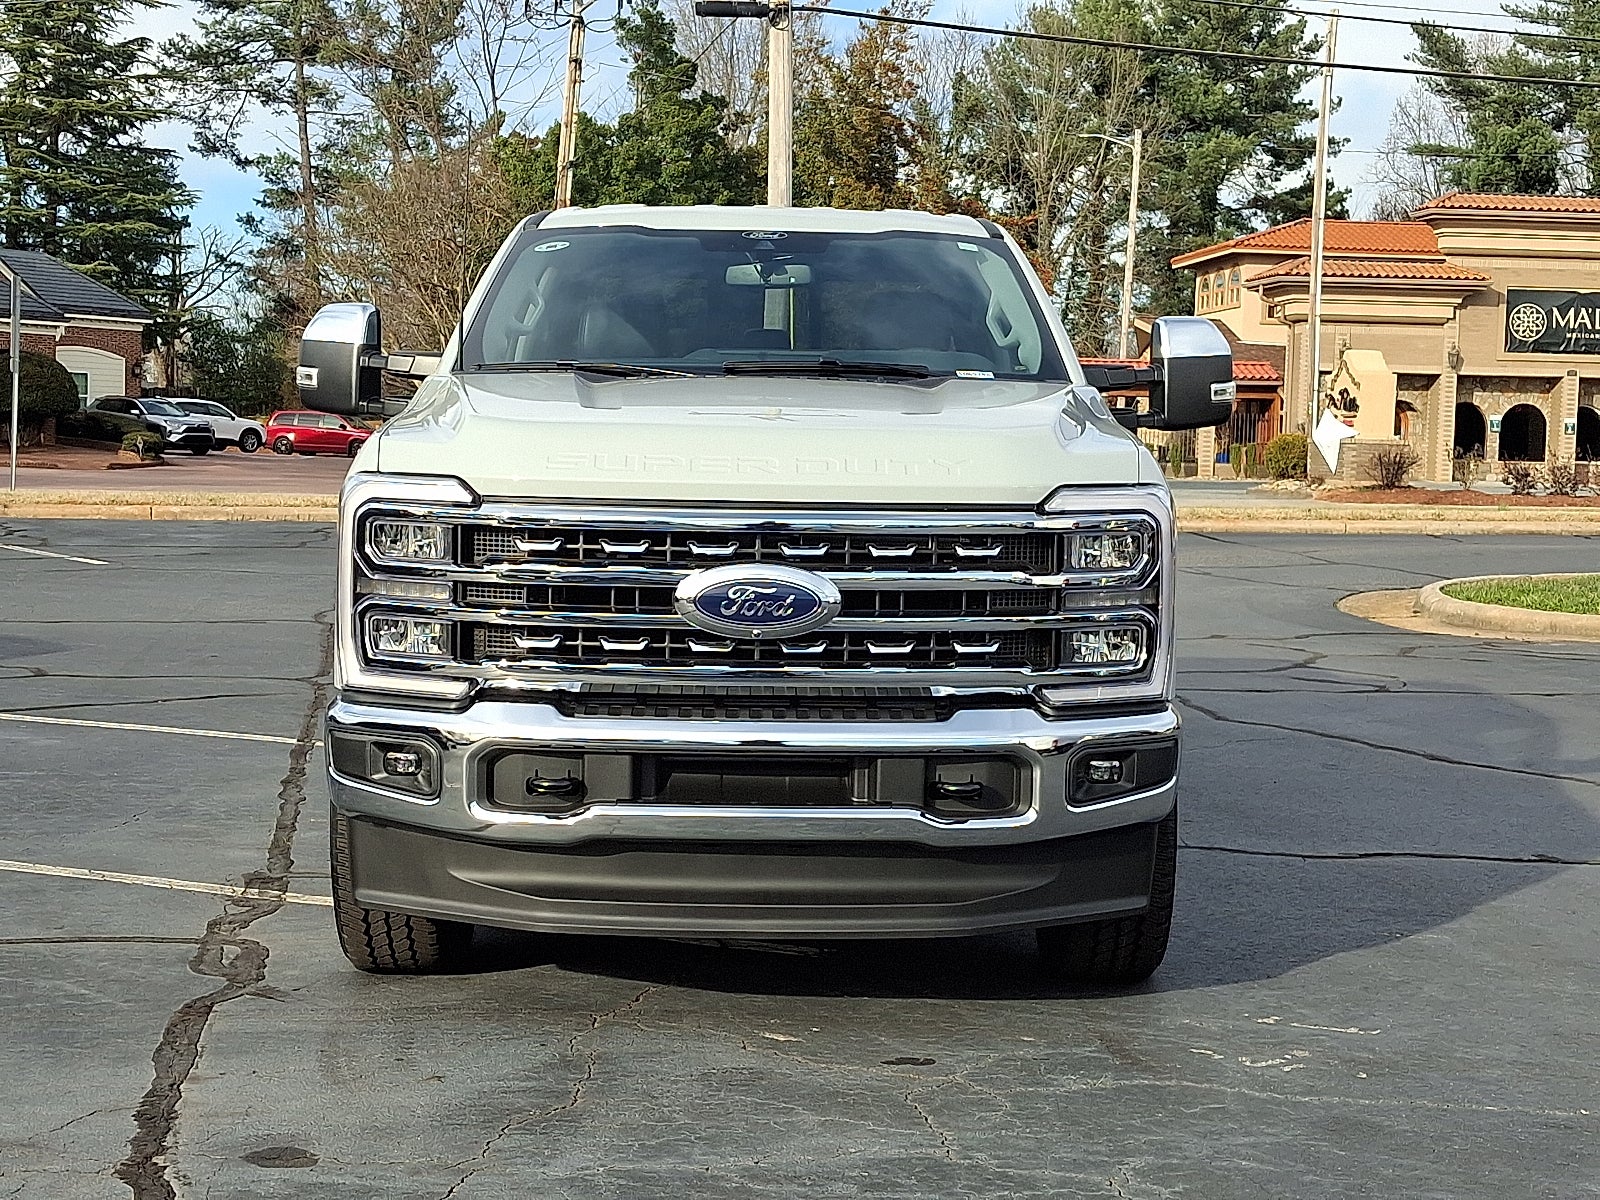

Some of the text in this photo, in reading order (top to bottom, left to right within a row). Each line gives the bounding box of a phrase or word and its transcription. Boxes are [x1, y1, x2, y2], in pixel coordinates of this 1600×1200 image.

[546, 451, 974, 476] SUPER DUTY
[720, 585, 796, 616] Ford
